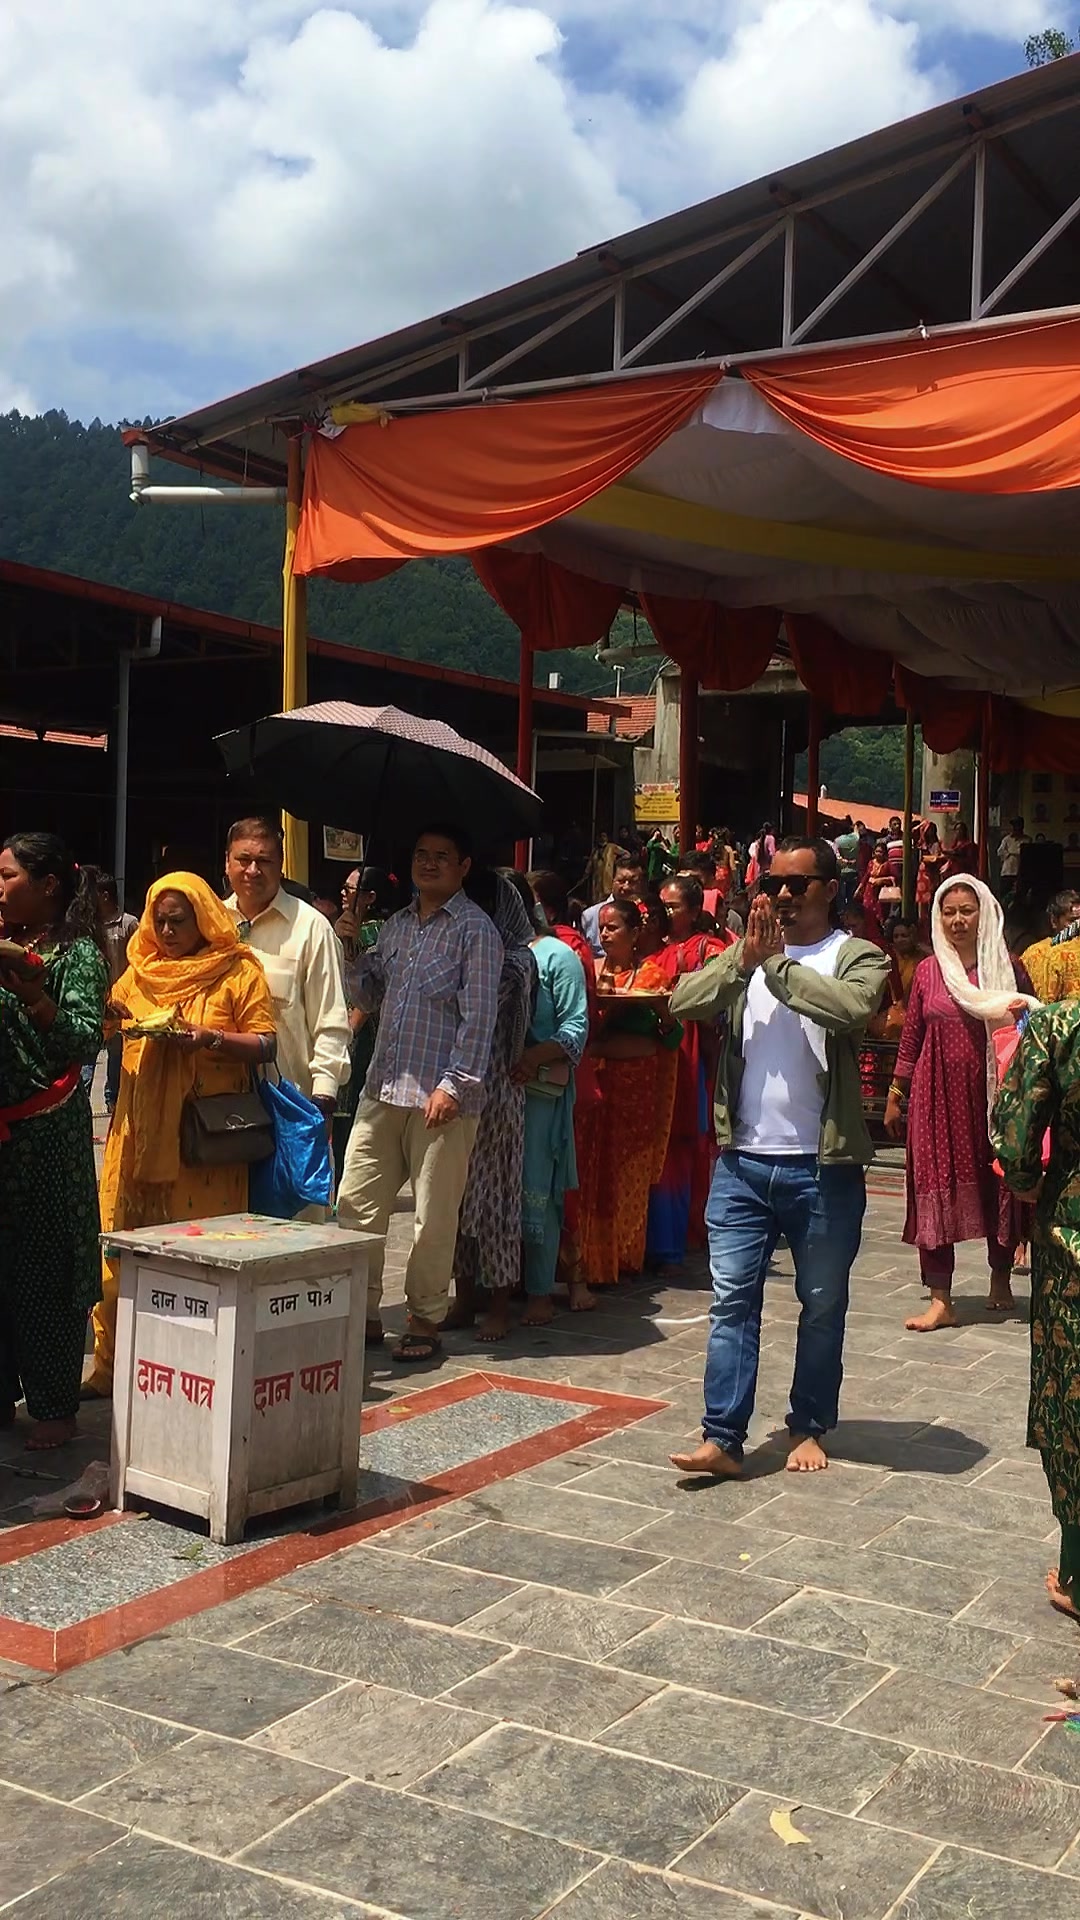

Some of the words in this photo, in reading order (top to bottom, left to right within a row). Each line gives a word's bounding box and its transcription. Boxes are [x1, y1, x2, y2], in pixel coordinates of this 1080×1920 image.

[151, 1289, 177, 1310] दान
[184, 1296, 209, 1317] पात्र
[270, 1294, 299, 1316] दान
[137, 1358, 175, 1400] दान
[180, 1371, 215, 1411] पात्र
[254, 1371, 294, 1417] दान
[300, 1359, 342, 1394] पात्र
